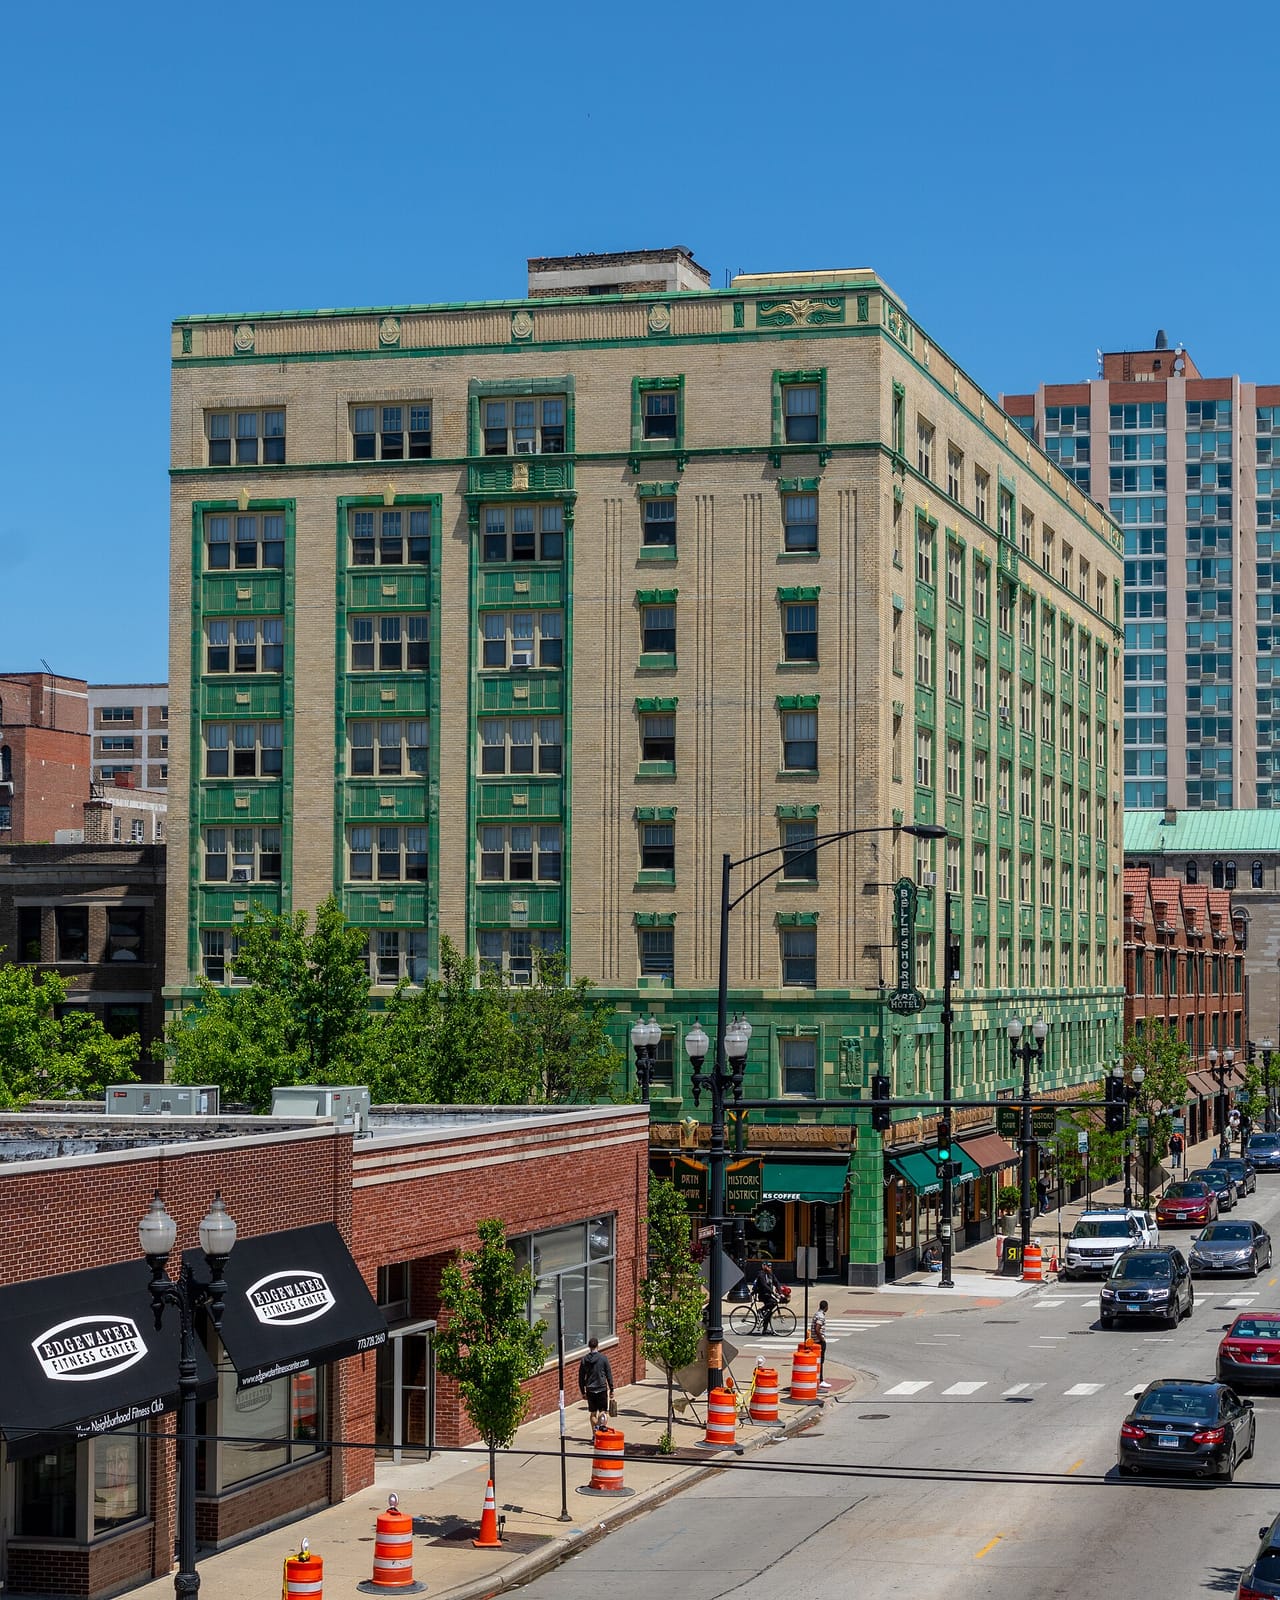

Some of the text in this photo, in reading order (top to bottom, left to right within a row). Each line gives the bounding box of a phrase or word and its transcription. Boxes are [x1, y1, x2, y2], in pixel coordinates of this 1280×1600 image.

[891, 1001, 920, 1009] HOTEL
[728, 1175, 760, 1185] HISTORIC
[728, 1190, 759, 1200] DISTRICT
[254, 1278, 323, 1305] EDGEWATER
[262, 1292, 328, 1317] FITNESS CENTER
[42, 1324, 133, 1358] EDGEWATER
[52, 1340, 138, 1371] FITNESS CENTER
[132, 1405, 150, 1420] Fitness
[151, 1398, 164, 1413] Club
